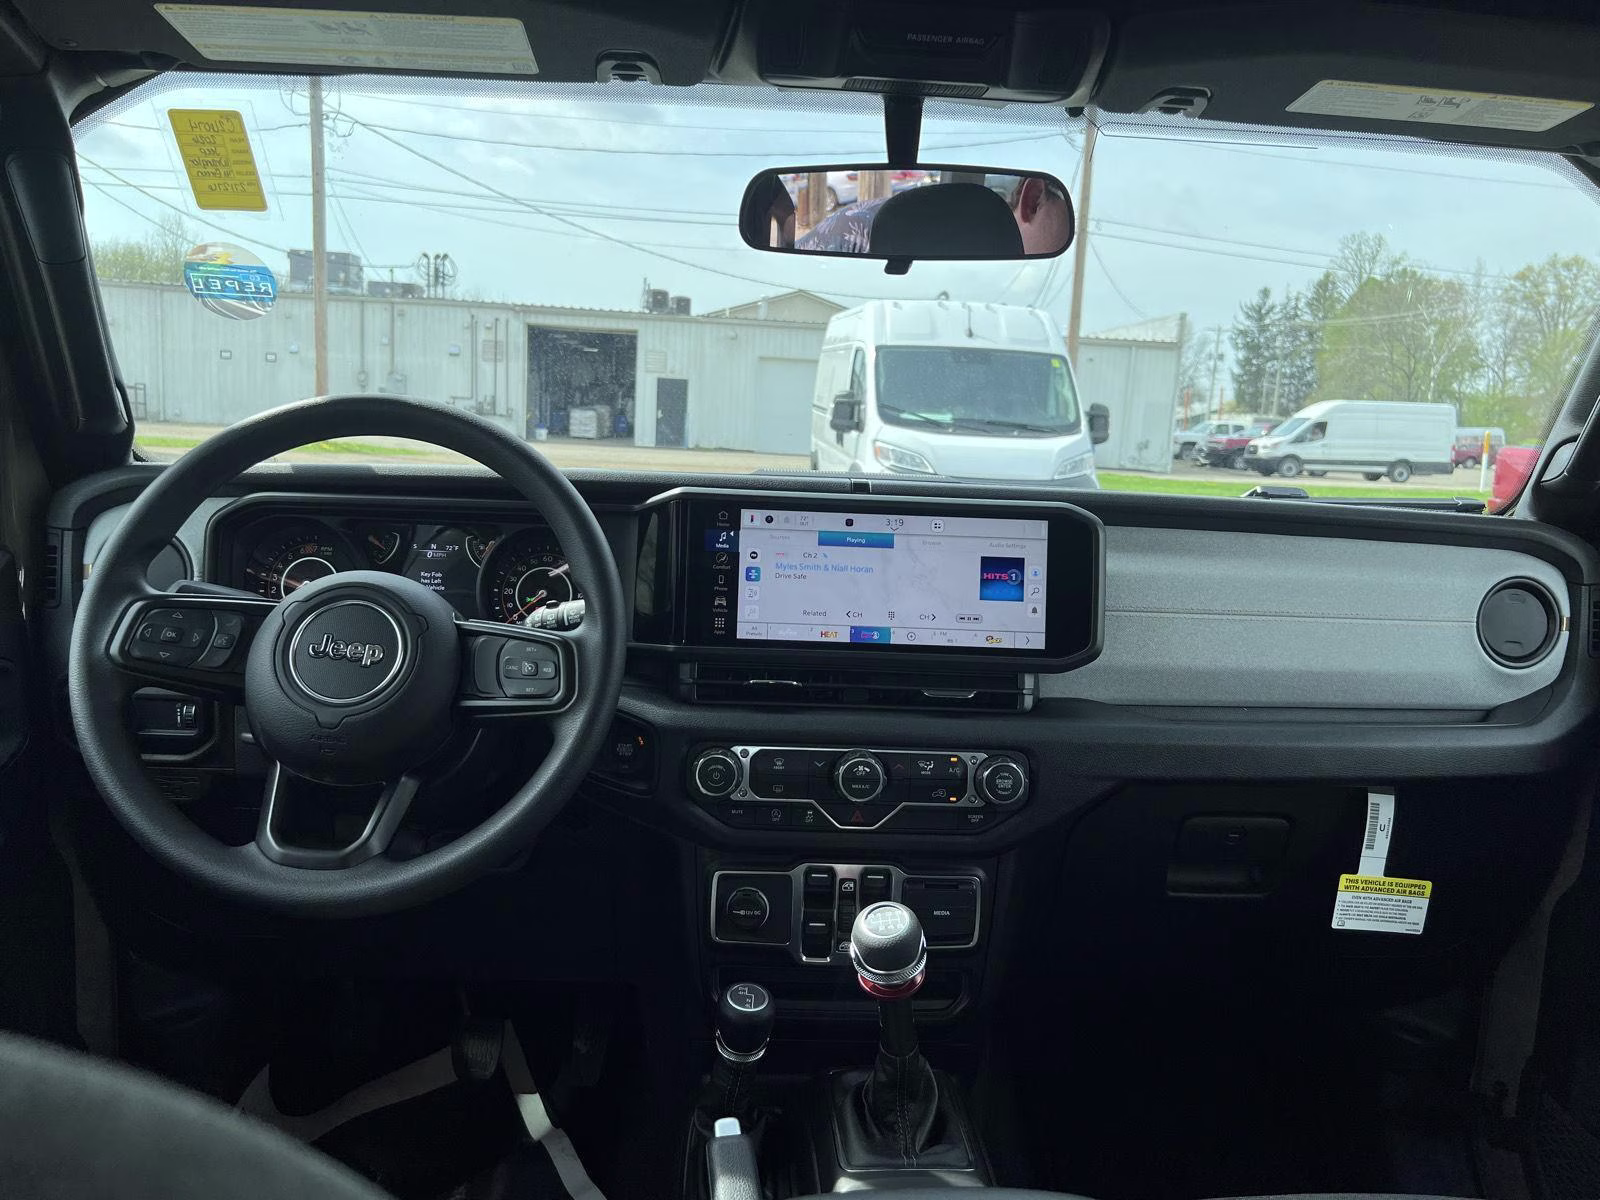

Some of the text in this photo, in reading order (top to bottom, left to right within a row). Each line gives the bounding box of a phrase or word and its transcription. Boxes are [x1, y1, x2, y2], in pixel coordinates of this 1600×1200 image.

[907, 33, 953, 43] PASSENGER
[775, 563, 798, 571] Myles
[800, 563, 821, 571] Smith
[831, 564, 849, 572] Niall
[983, 572, 1008, 580] HITS
[271, 586, 277, 594] 2
[308, 632, 385, 668] Jeep
[1361, 886, 1395, 894] ADVANCED
[1395, 882, 1427, 890] EQUIPPED
